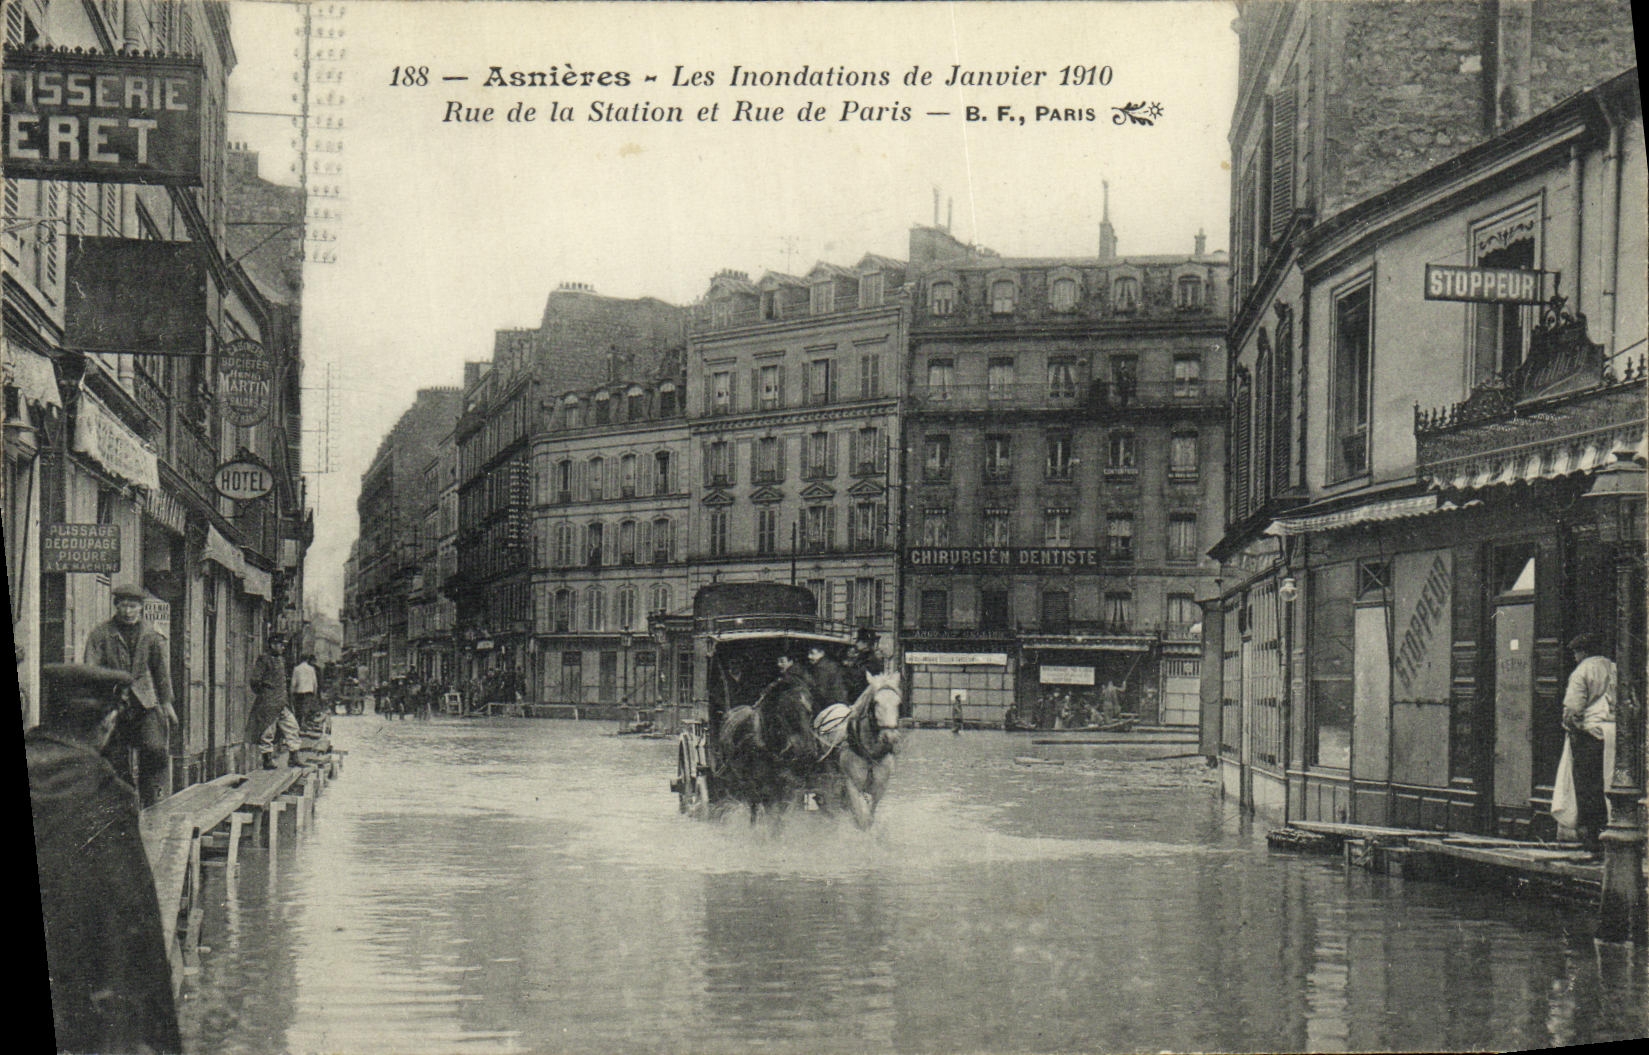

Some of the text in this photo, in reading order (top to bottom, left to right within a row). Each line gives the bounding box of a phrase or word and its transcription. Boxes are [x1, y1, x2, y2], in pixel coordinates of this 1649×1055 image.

[1430, 269, 1535, 301] STOPPEUR
[218, 372, 270, 395] MARTIN
[221, 470, 266, 491] HOTEL
[50, 525, 117, 537] PLISSAGE
[45, 538, 118, 550] DECOUPAGE
[1019, 550, 1097, 566] DENTISTE
